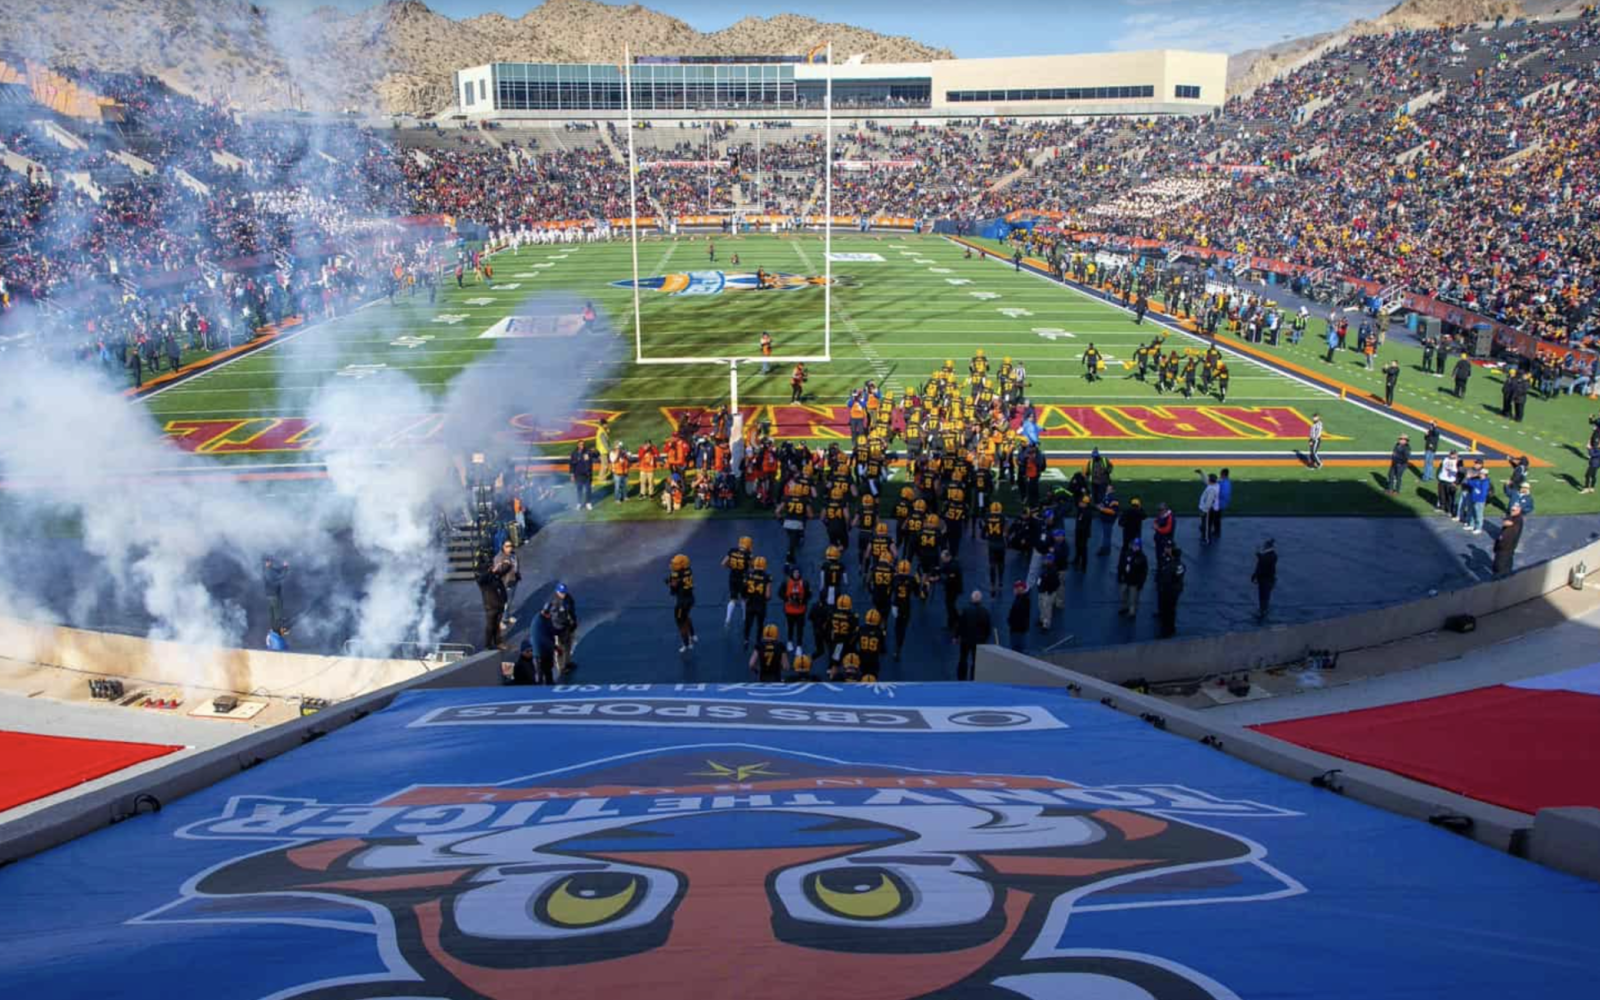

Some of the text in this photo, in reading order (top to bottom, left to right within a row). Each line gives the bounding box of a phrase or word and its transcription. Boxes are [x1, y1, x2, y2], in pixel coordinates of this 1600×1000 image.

[947, 508, 963, 520] 57
[988, 522, 1001, 535] 14
[747, 580, 764, 594] 34
[764, 651, 774, 666] 7
[456, 703, 910, 726] CBS SPORTS
[816, 778, 1006, 787] SUN
[207, 787, 1258, 835] TONY THE TIGER
